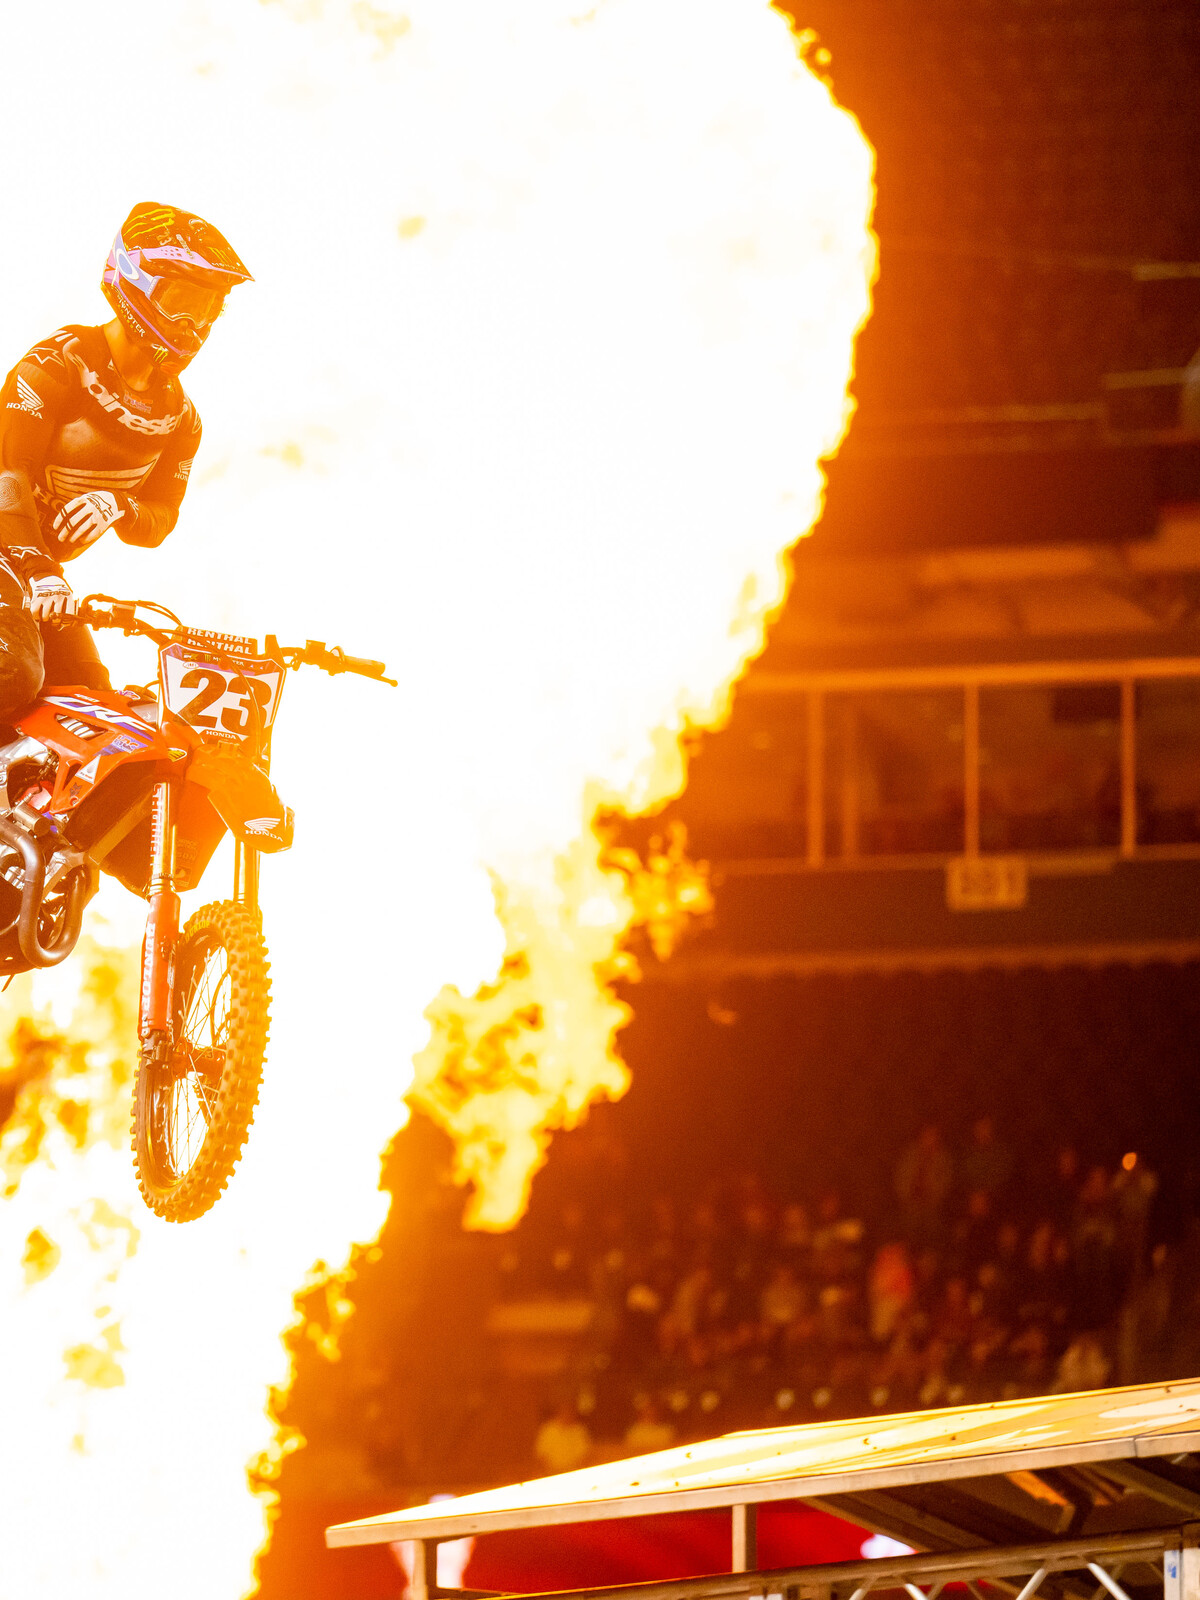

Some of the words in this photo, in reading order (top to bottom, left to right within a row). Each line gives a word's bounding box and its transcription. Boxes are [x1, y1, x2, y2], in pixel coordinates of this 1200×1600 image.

[6, 402, 43, 420] HONDA
[174, 472, 189, 482] HON
[187, 627, 253, 645] RENTHAL
[177, 668, 272, 736] 23
[44, 696, 157, 732] CRF
[206, 730, 237, 740] HONDA
[245, 829, 283, 842] HONDA
[184, 920, 211, 942] DUNLOP
[141, 921, 156, 1012] DUNLOP
